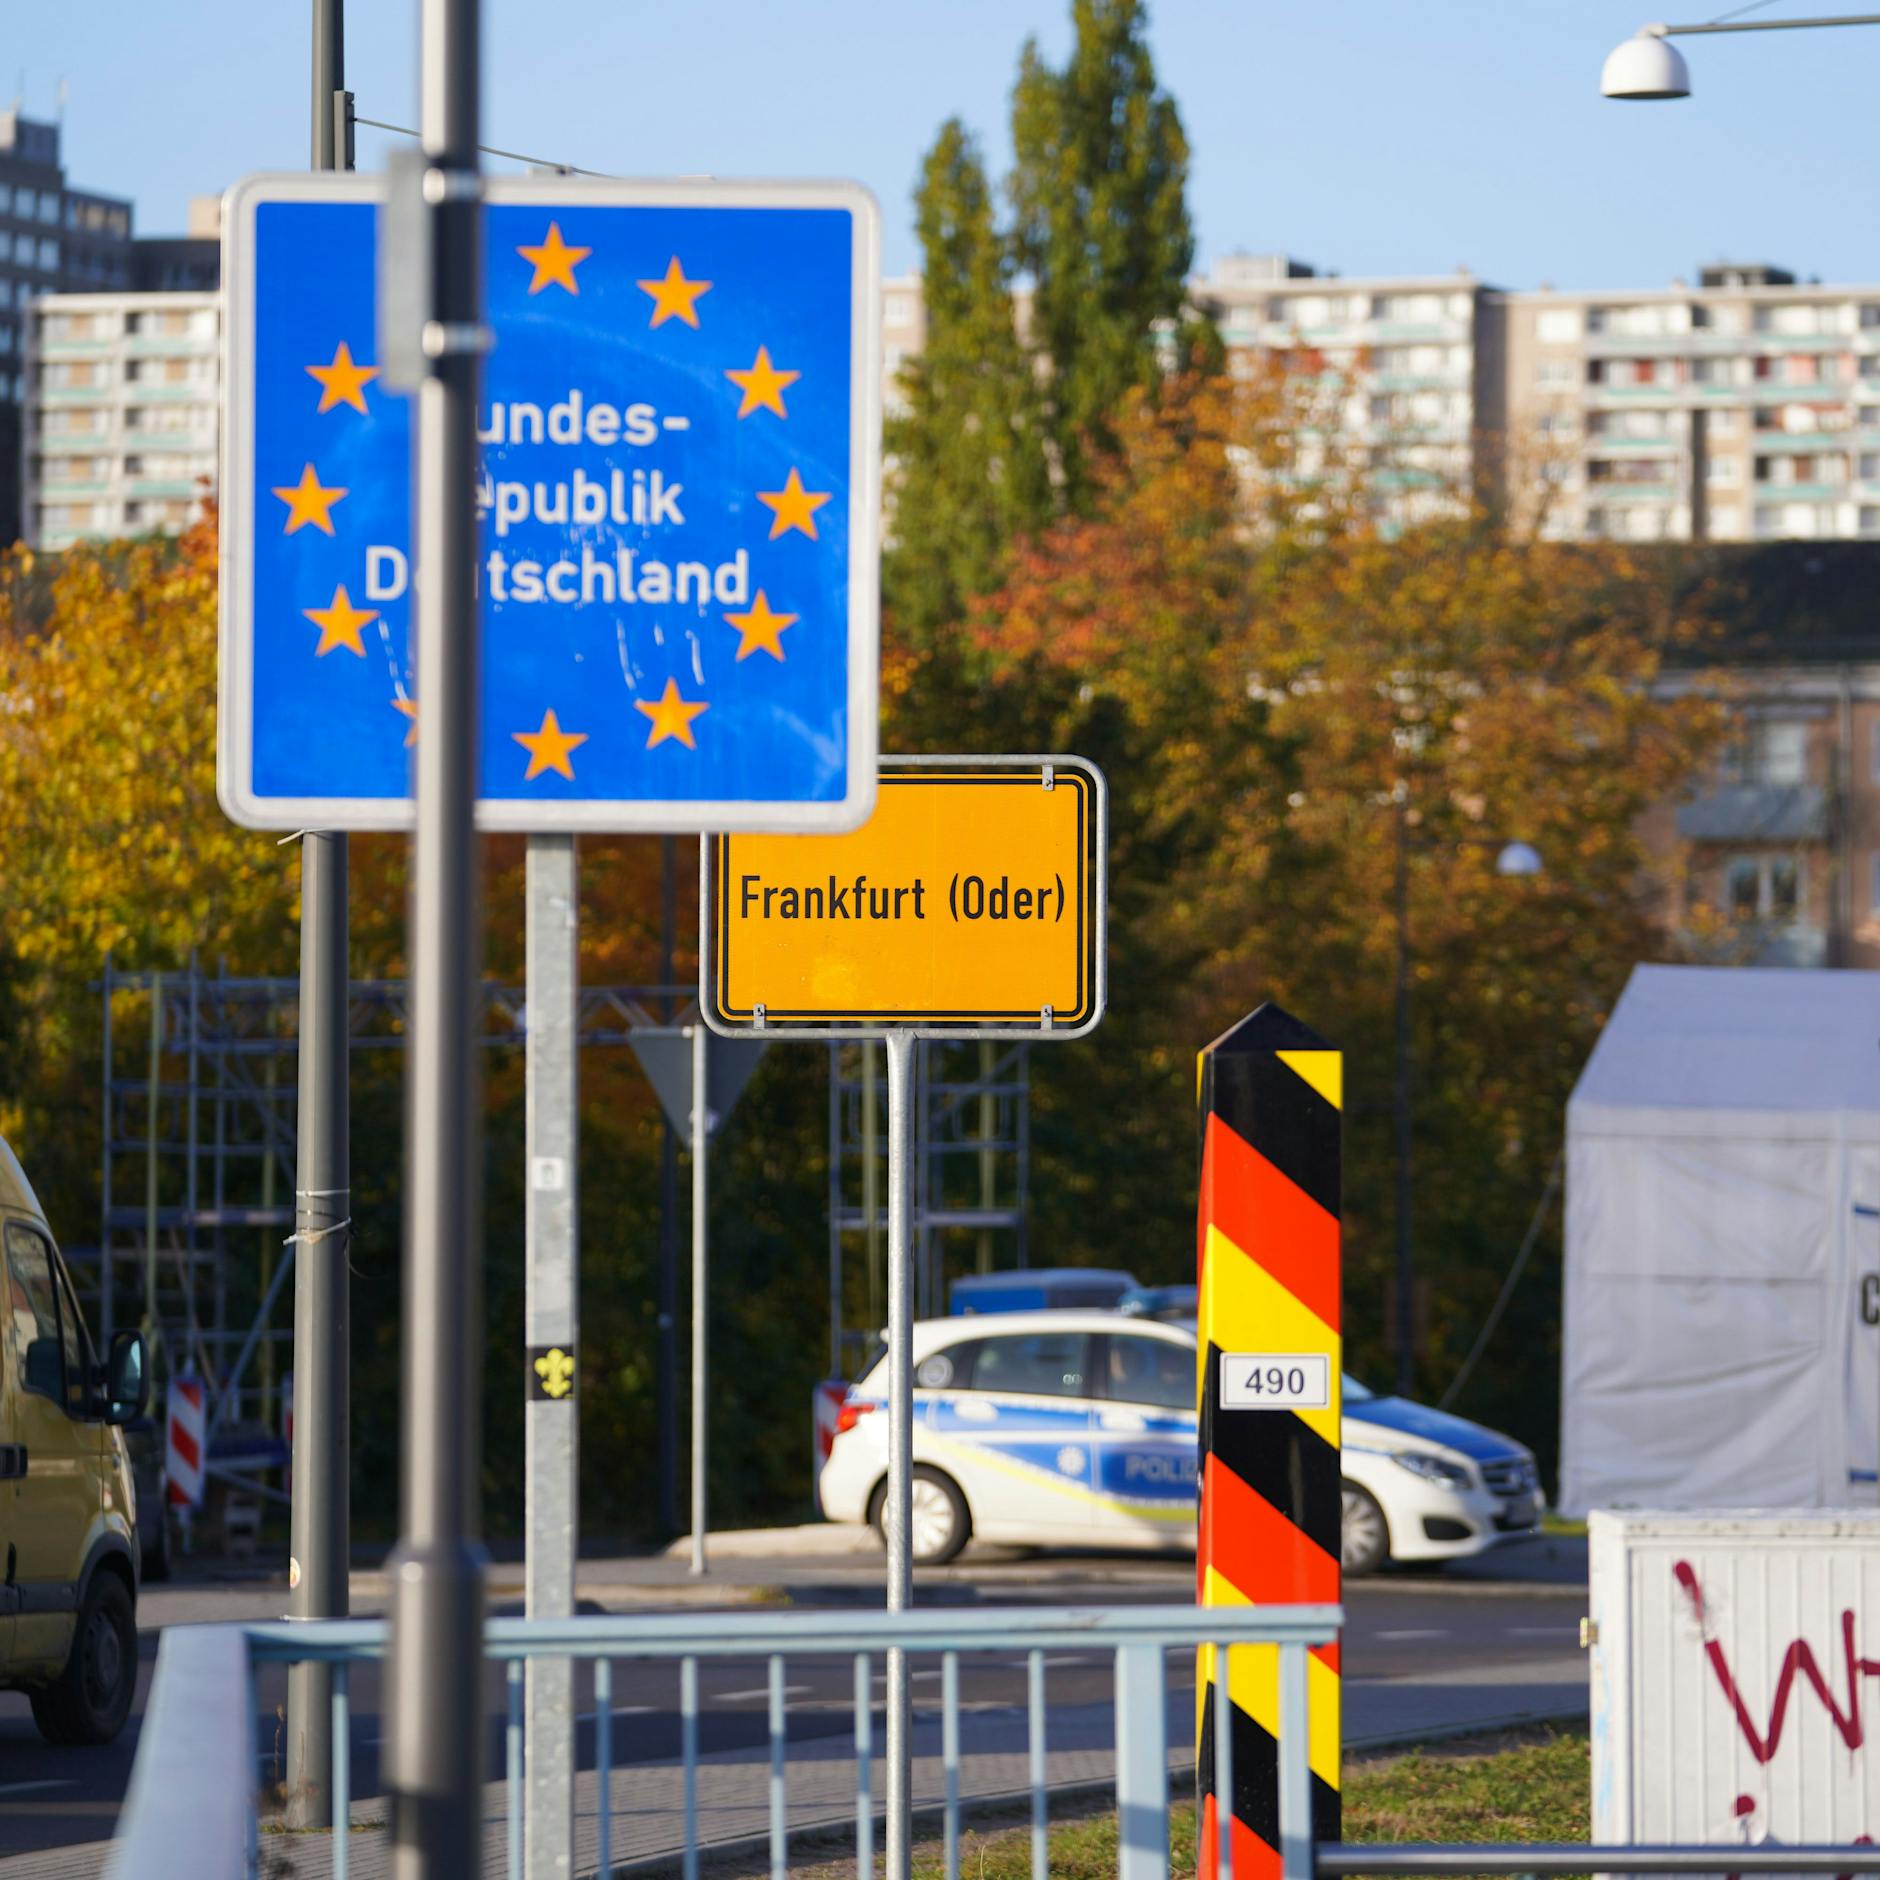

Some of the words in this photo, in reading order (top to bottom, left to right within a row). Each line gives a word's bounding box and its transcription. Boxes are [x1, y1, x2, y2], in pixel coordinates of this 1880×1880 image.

[476, 389, 690, 444] undes-
[476, 469, 685, 537] publik
[365, 541, 749, 604] Dtschland
[741, 875, 925, 920] Frankfurt
[949, 873, 1065, 922] (Oder)
[1245, 1368, 1305, 1394] 490
[1125, 1455, 1198, 1482] POLIZ
